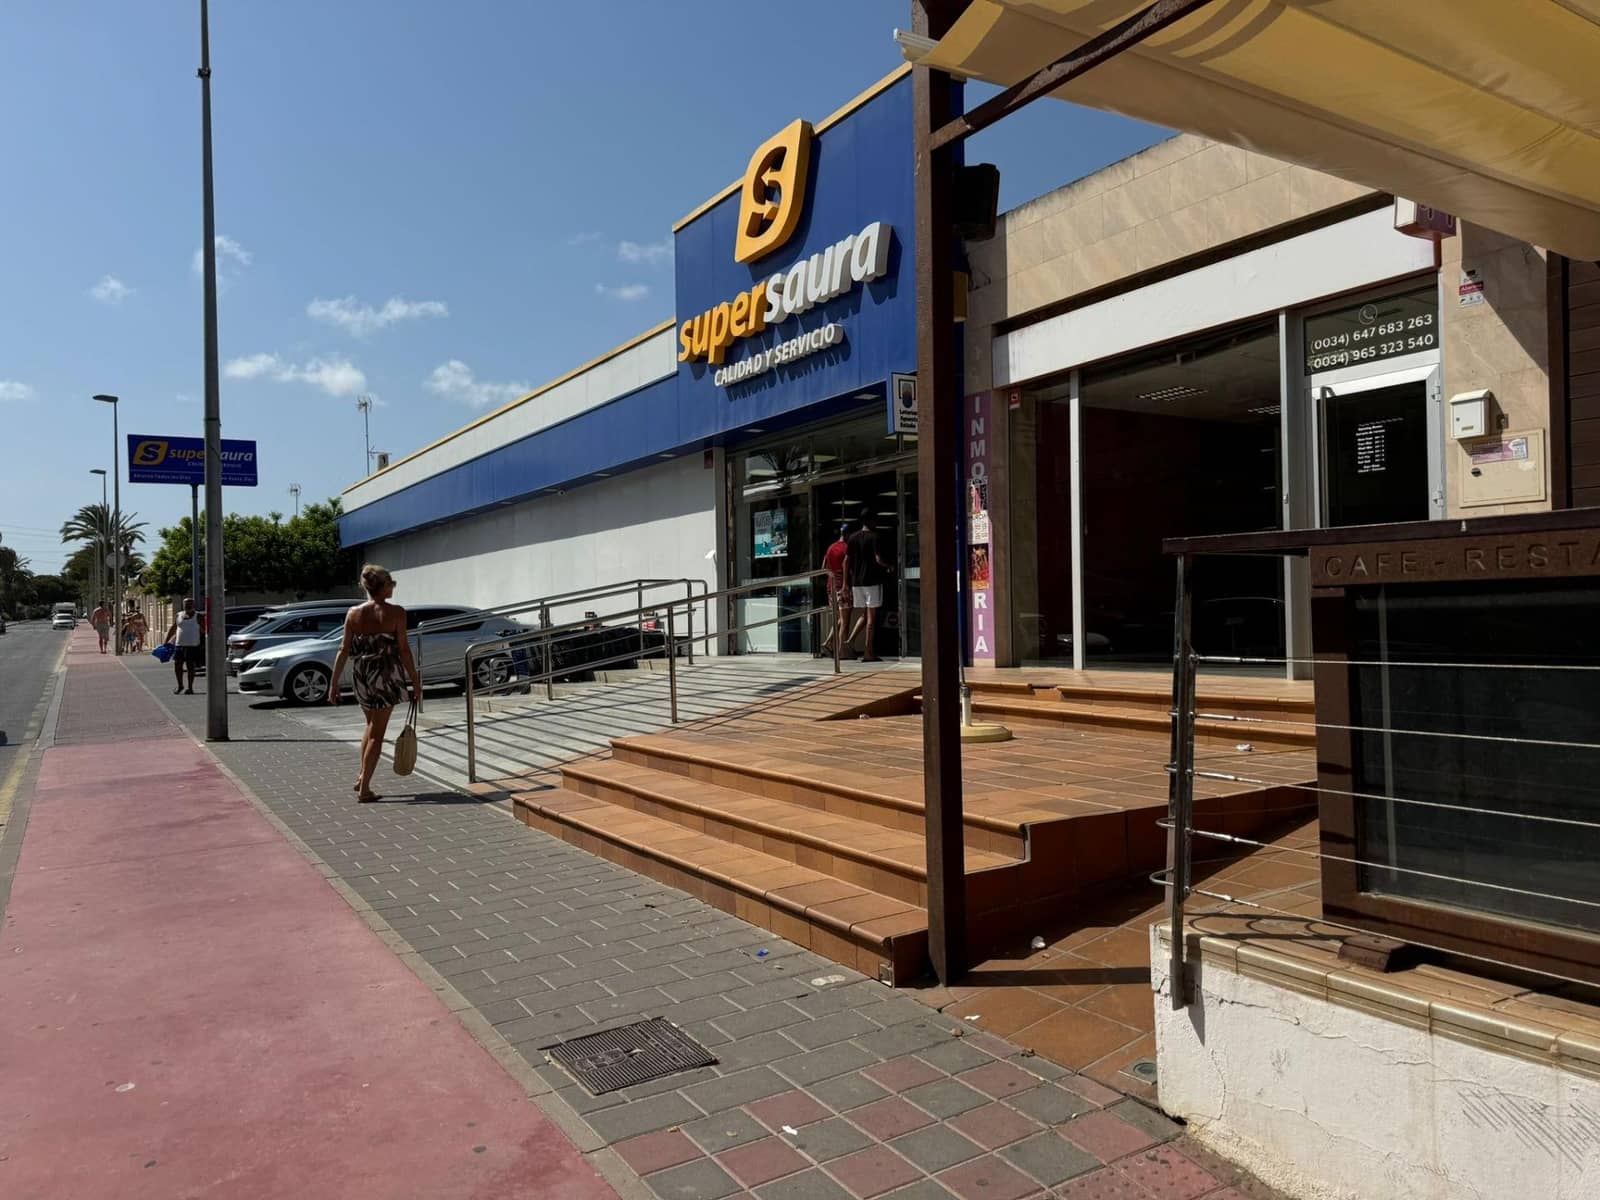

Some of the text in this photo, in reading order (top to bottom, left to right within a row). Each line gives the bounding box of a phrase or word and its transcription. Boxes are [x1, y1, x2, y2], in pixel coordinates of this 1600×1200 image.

[678, 221, 886, 365] supersaura
[1310, 313, 1433, 354] (0034) 647 683 263
[1352, 346, 1376, 361] 965
[1380, 340, 1403, 355] 323
[1407, 333, 1434, 349] 540
[714, 354, 764, 387] CALIDAD
[774, 323, 841, 364] SERVICIO
[168, 448, 254, 463] supeaura
[1324, 551, 1417, 577] CAFE
